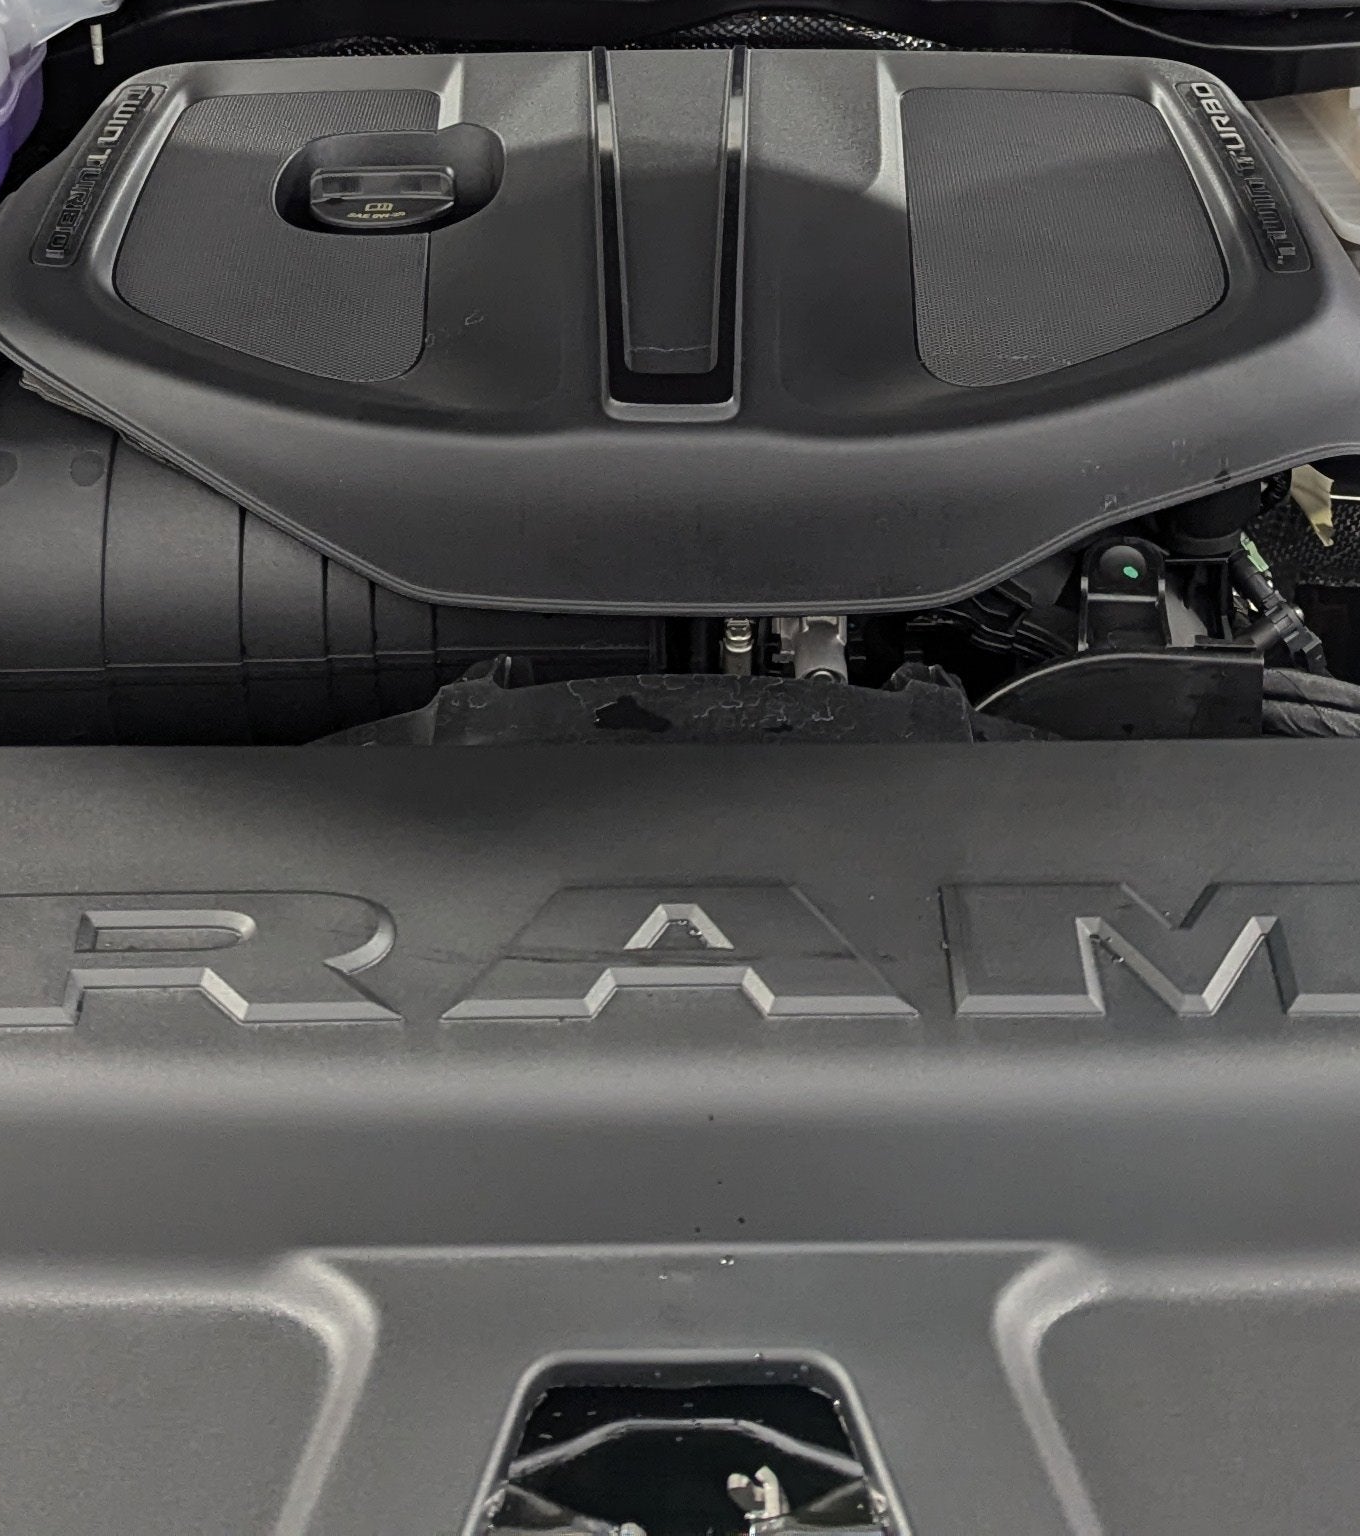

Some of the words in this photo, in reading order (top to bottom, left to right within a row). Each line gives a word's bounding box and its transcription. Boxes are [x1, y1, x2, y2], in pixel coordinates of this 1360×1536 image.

[97, 86, 152, 148] TWIN
[1191, 82, 1255, 173] TURBO
[45, 149, 112, 259] TURBO
